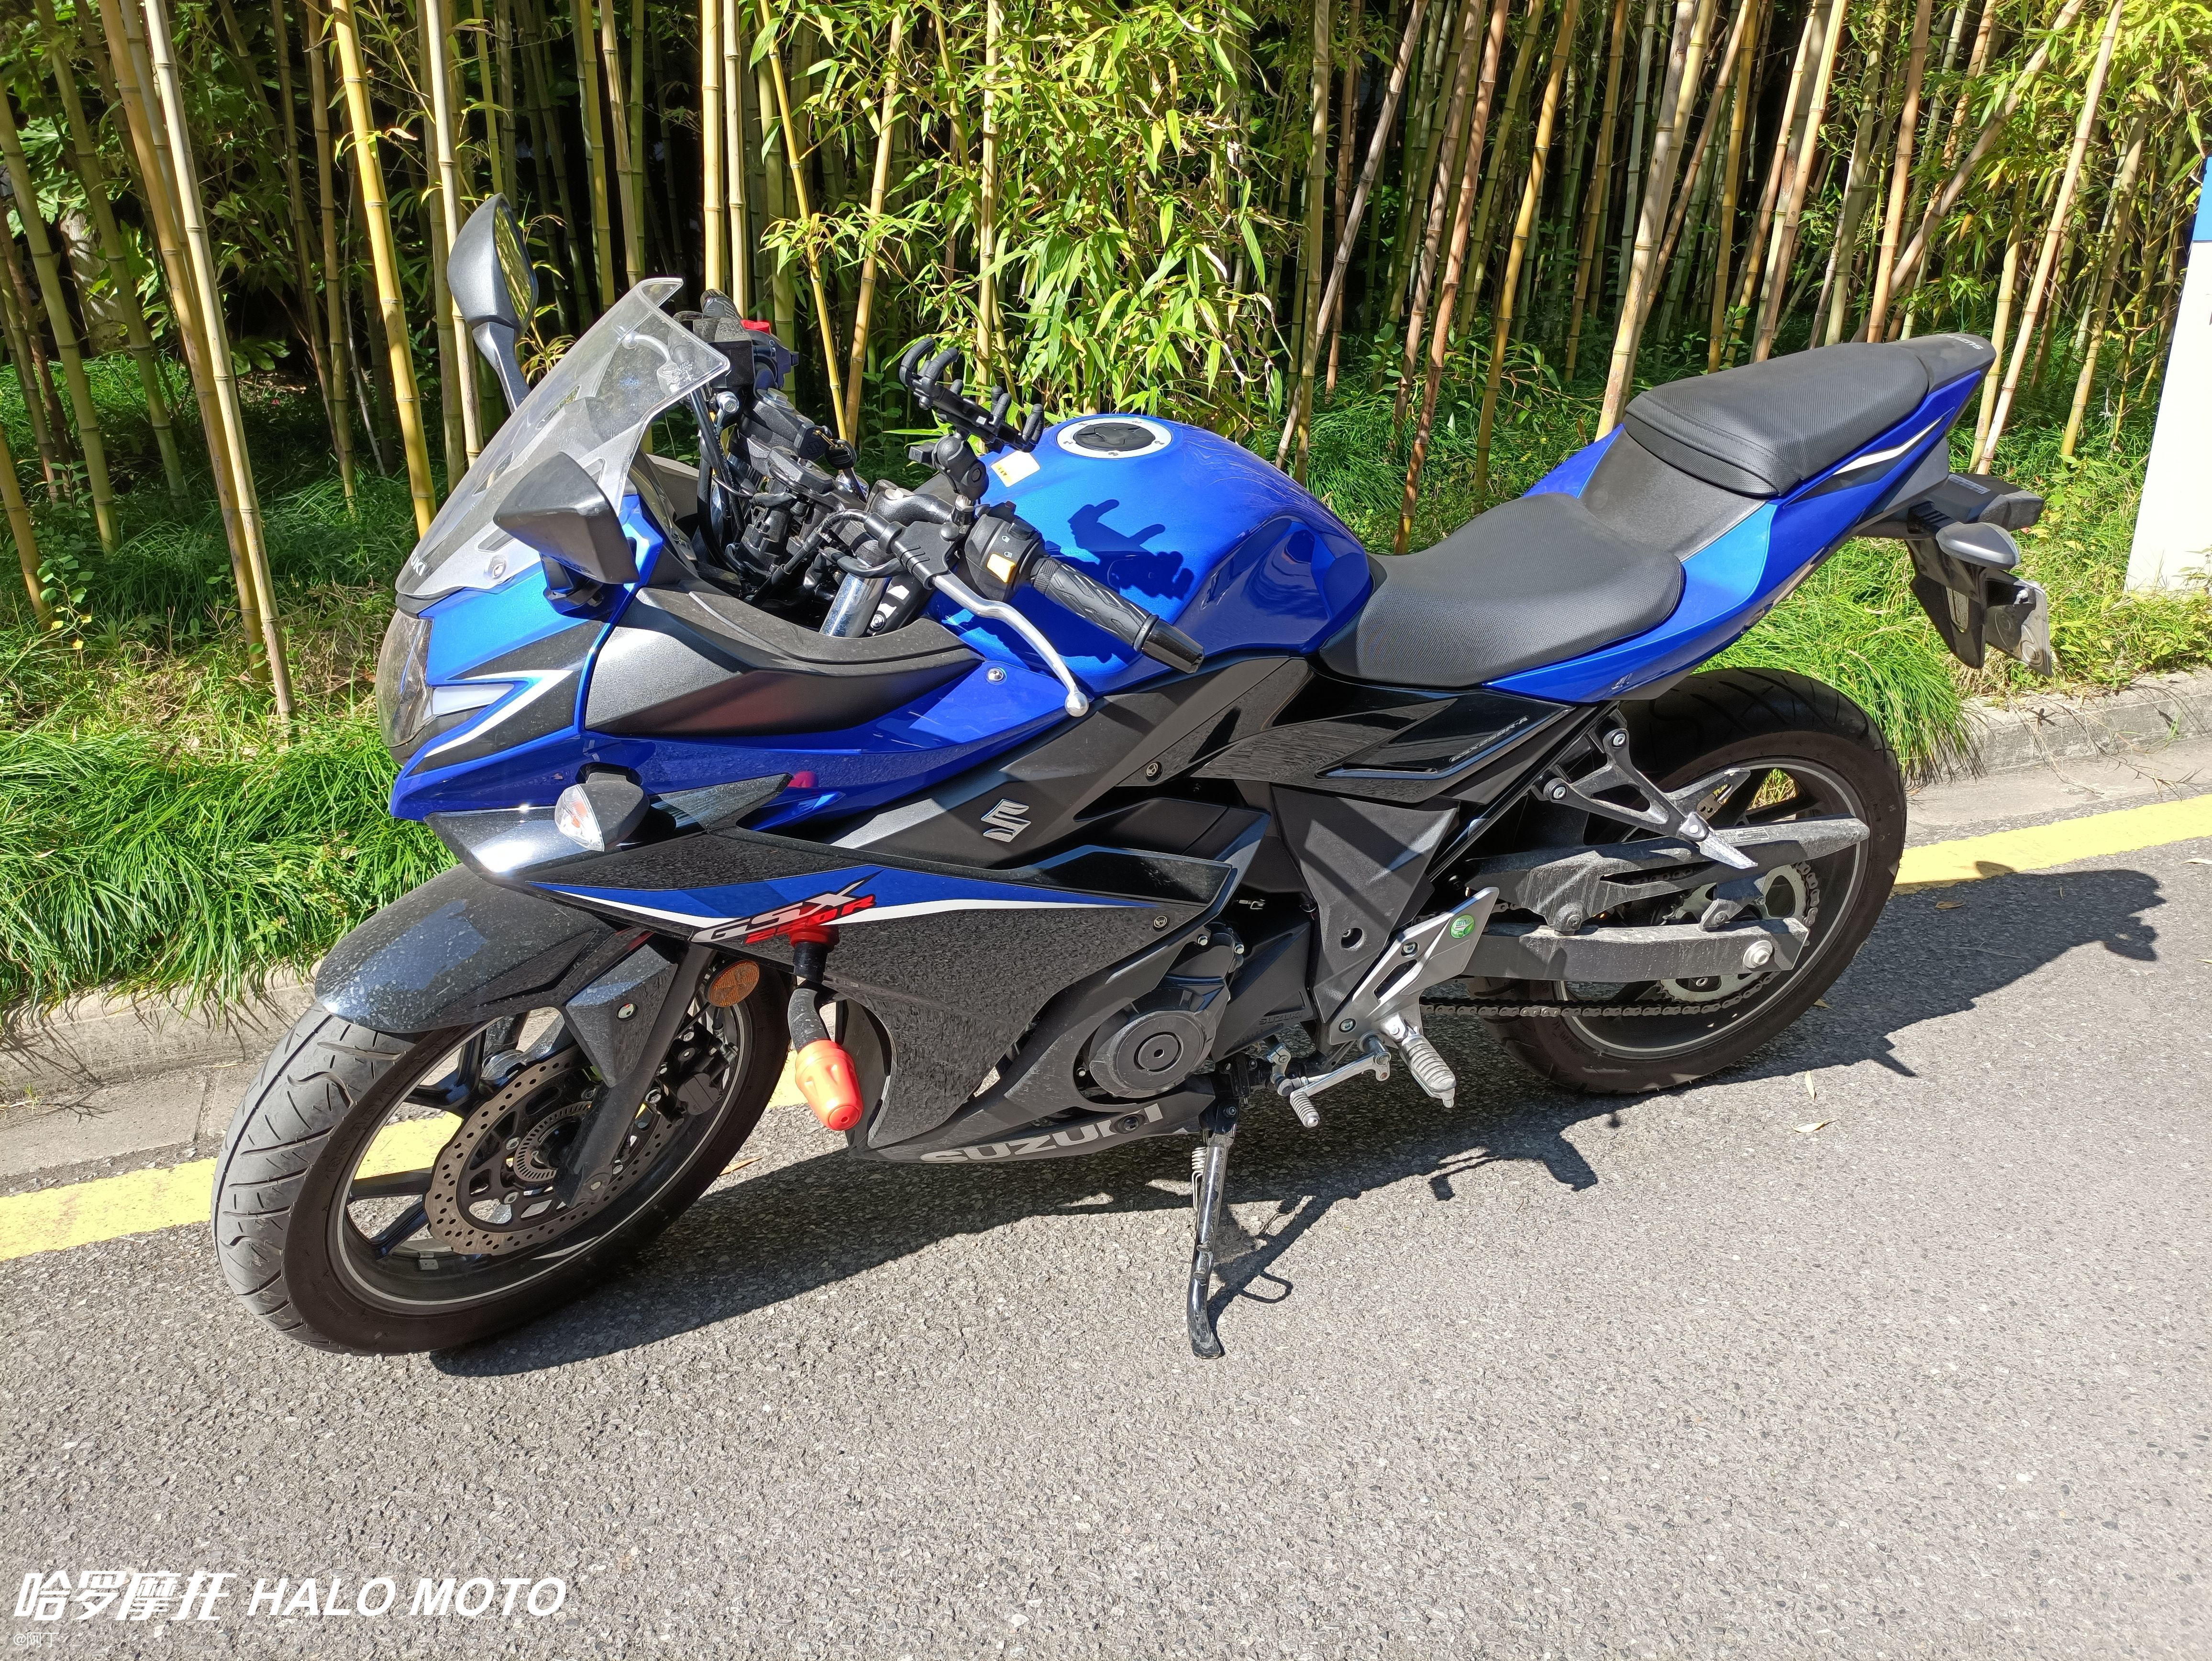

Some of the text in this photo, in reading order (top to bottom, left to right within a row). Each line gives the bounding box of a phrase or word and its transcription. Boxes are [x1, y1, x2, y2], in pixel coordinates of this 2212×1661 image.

[1451, 717, 1528, 761] GSX250R-A
[690, 879, 865, 943] GSX
[744, 895, 876, 944] 250R
[1259, 1011, 1304, 1025] SUZUKI
